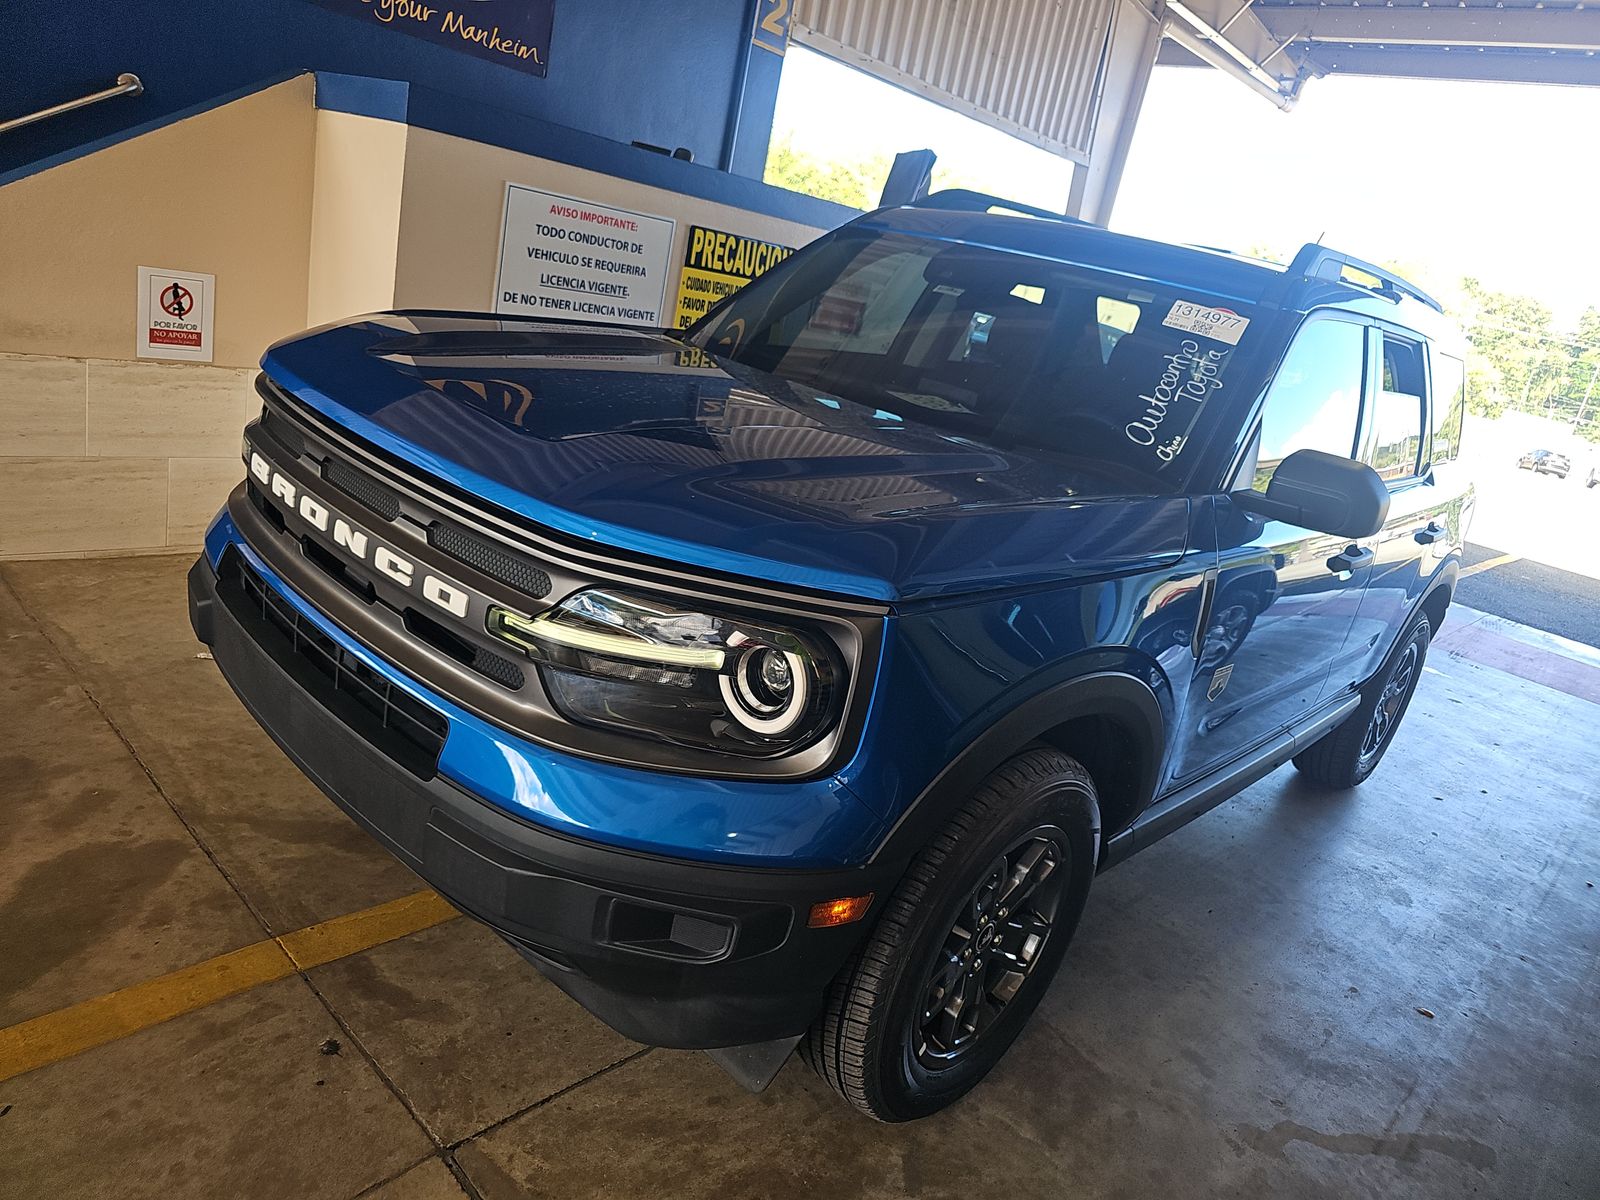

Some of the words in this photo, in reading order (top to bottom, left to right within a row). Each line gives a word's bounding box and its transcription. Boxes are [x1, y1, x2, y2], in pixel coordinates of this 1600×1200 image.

[374, 0, 438, 22] your
[761, 0, 788, 37] 2
[550, 204, 578, 219] AVISO
[580, 210, 638, 232] IMPORTANTE:
[536, 224, 566, 239] TODO
[568, 231, 629, 251] CONDUCTOR
[630, 243, 643, 255] DE
[527, 247, 579, 266] VEHICULO
[581, 257, 593, 268] SE
[595, 259, 646, 277] REQUERIRA
[540, 273, 586, 290] LICENCIA
[588, 281, 630, 297] VIGENTE.
[686, 276, 711, 293] CUIDADO
[503, 291, 518, 303] DE
[520, 294, 537, 306] NO
[539, 297, 571, 310] TENER
[573, 301, 616, 316] LICENCIA
[617, 307, 655, 321] VIGENTE
[682, 296, 706, 312] FAVOR
[1175, 303, 1241, 329] 1314977
[154, 321, 171, 329] POR
[172, 322, 198, 330] FAVOR
[168, 331, 198, 340] APOYAR
[251, 452, 470, 618] BRONCO
